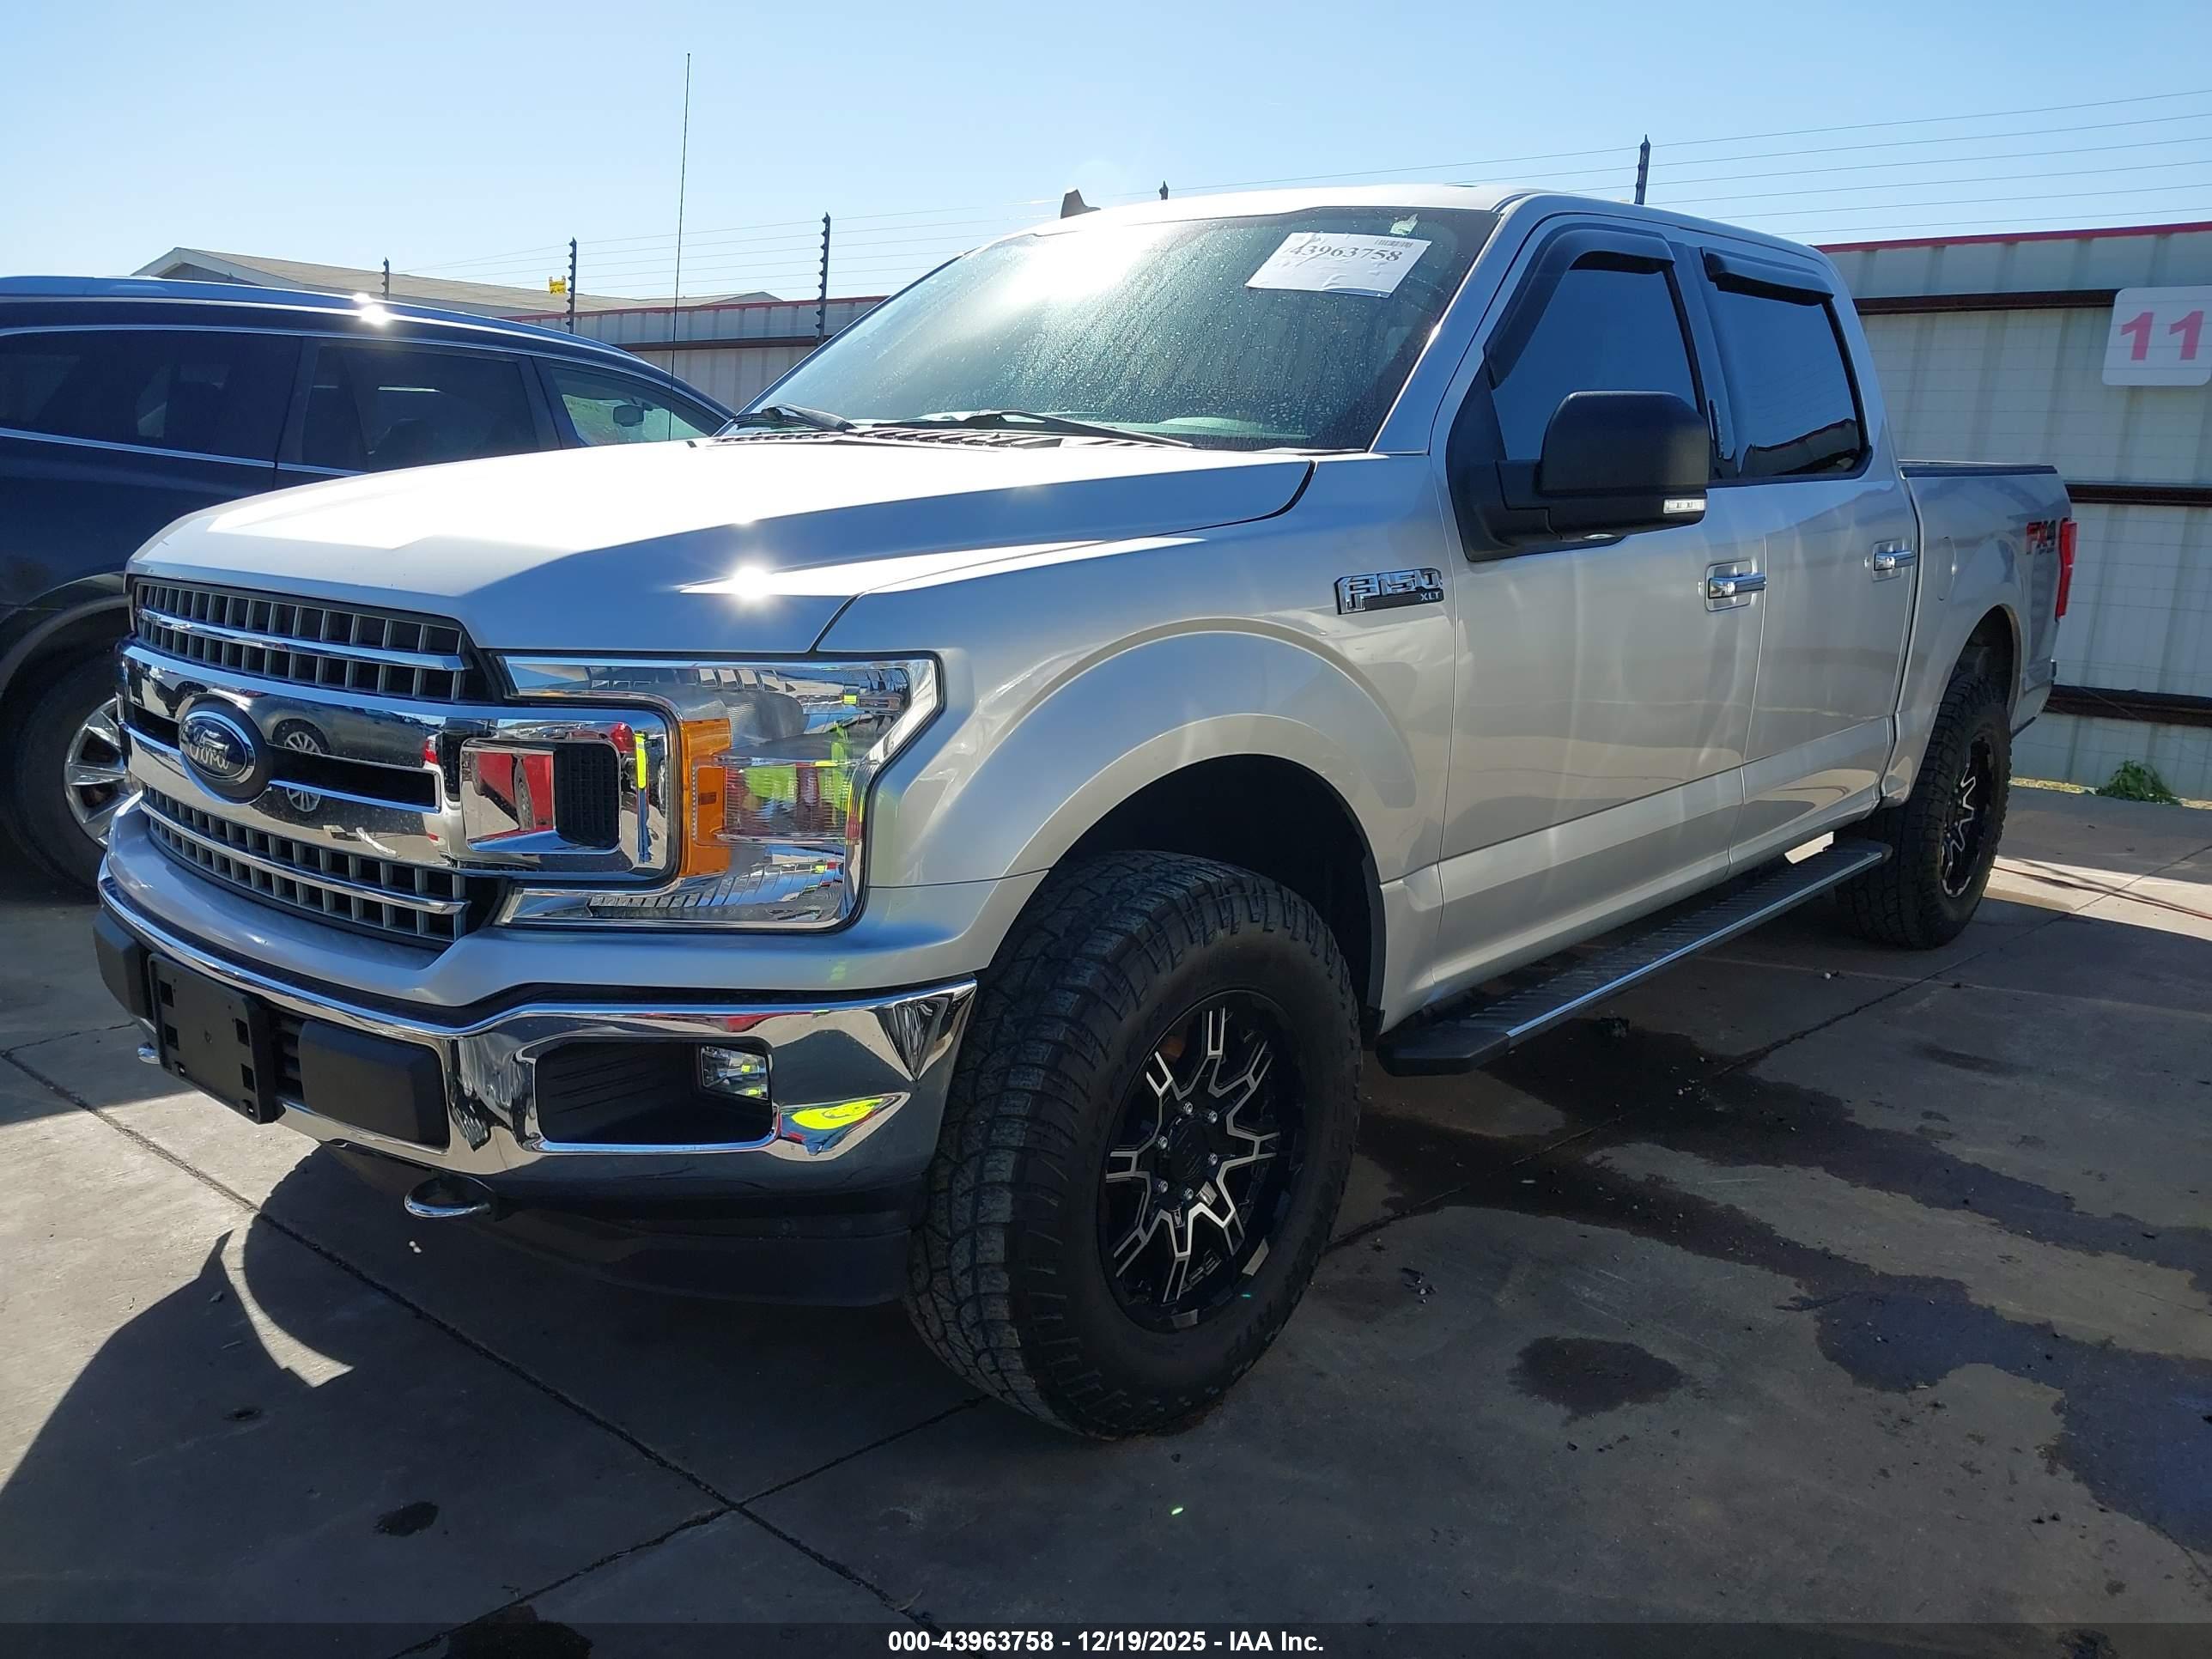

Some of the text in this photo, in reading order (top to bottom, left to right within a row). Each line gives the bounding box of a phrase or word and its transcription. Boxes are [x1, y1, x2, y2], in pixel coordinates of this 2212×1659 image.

[1290, 244, 1403, 262] 43963758
[2121, 310, 2204, 361] 11
[1420, 591, 1441, 601] XLT
[190, 725, 230, 770] Ford
